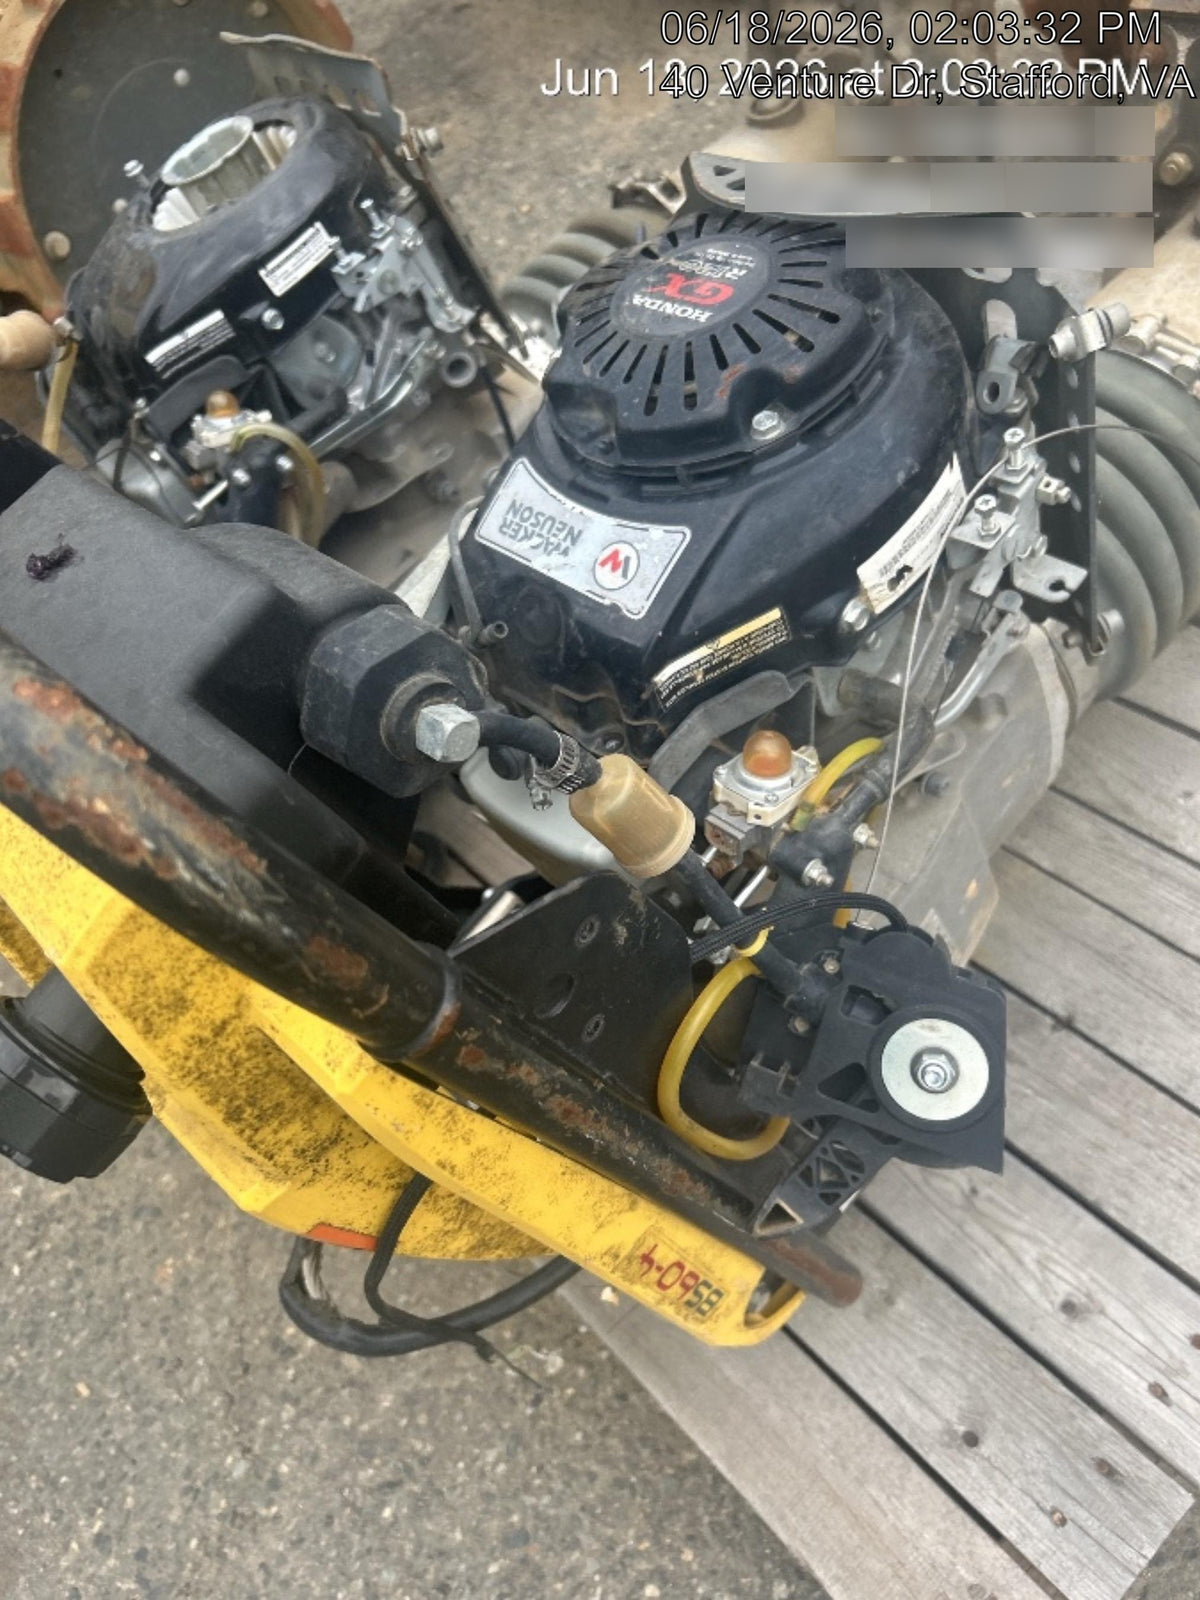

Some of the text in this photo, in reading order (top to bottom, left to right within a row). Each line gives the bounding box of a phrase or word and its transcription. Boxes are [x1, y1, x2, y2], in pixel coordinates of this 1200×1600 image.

[632, 293, 714, 323] HONDA
[505, 499, 583, 547] NEUSON
[639, 1243, 725, 1317] BS60-4
